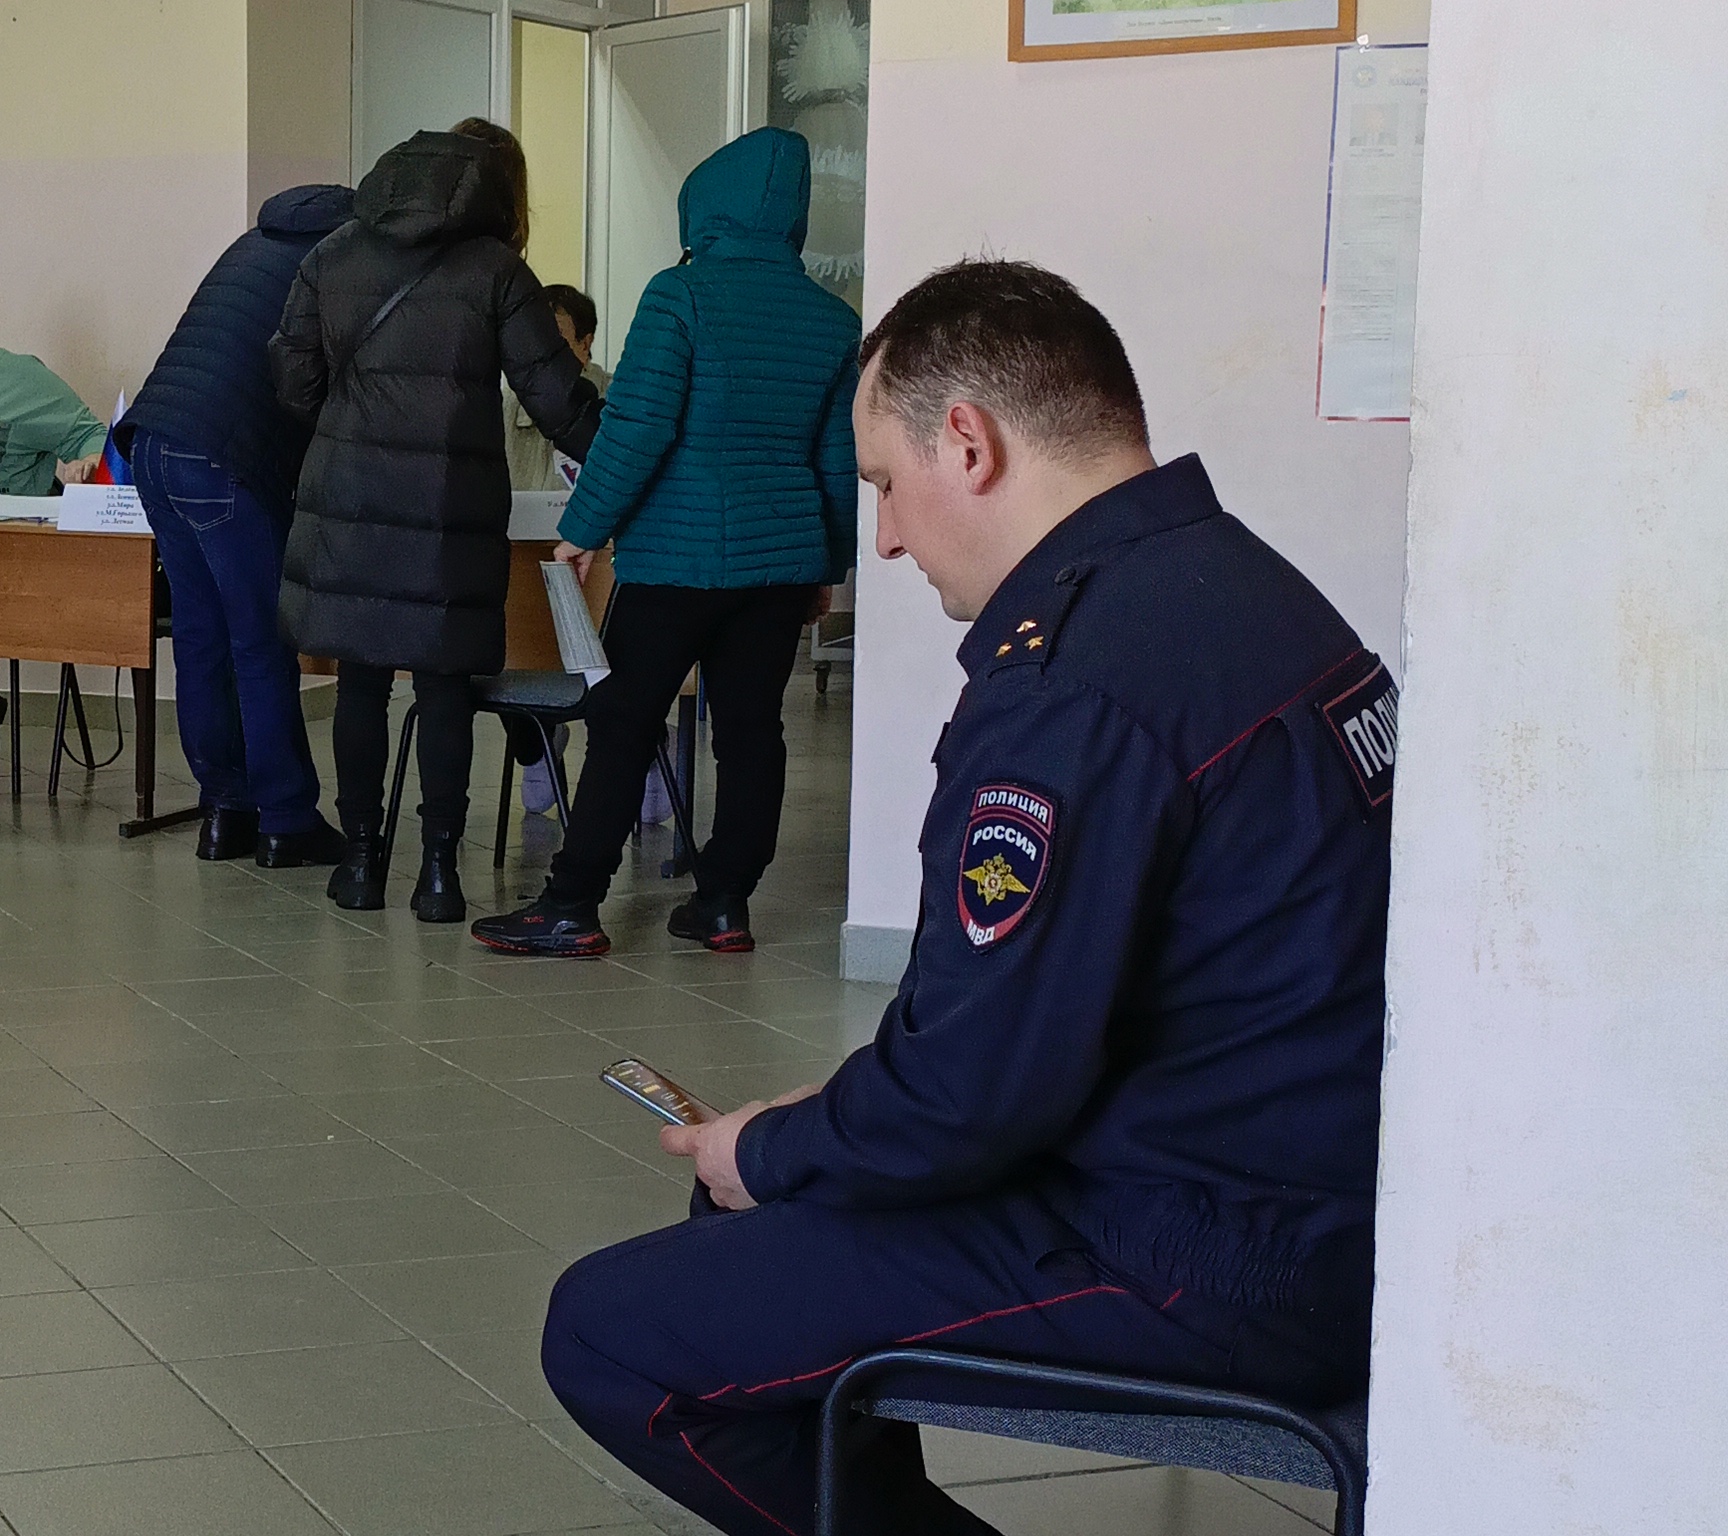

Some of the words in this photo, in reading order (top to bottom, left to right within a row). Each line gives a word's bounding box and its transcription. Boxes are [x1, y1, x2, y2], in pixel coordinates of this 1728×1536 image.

[978, 791, 1049, 824] ПОЛИЦИЯ
[972, 825, 1038, 861] РОССИЯ
[966, 919, 995, 946] МВД
